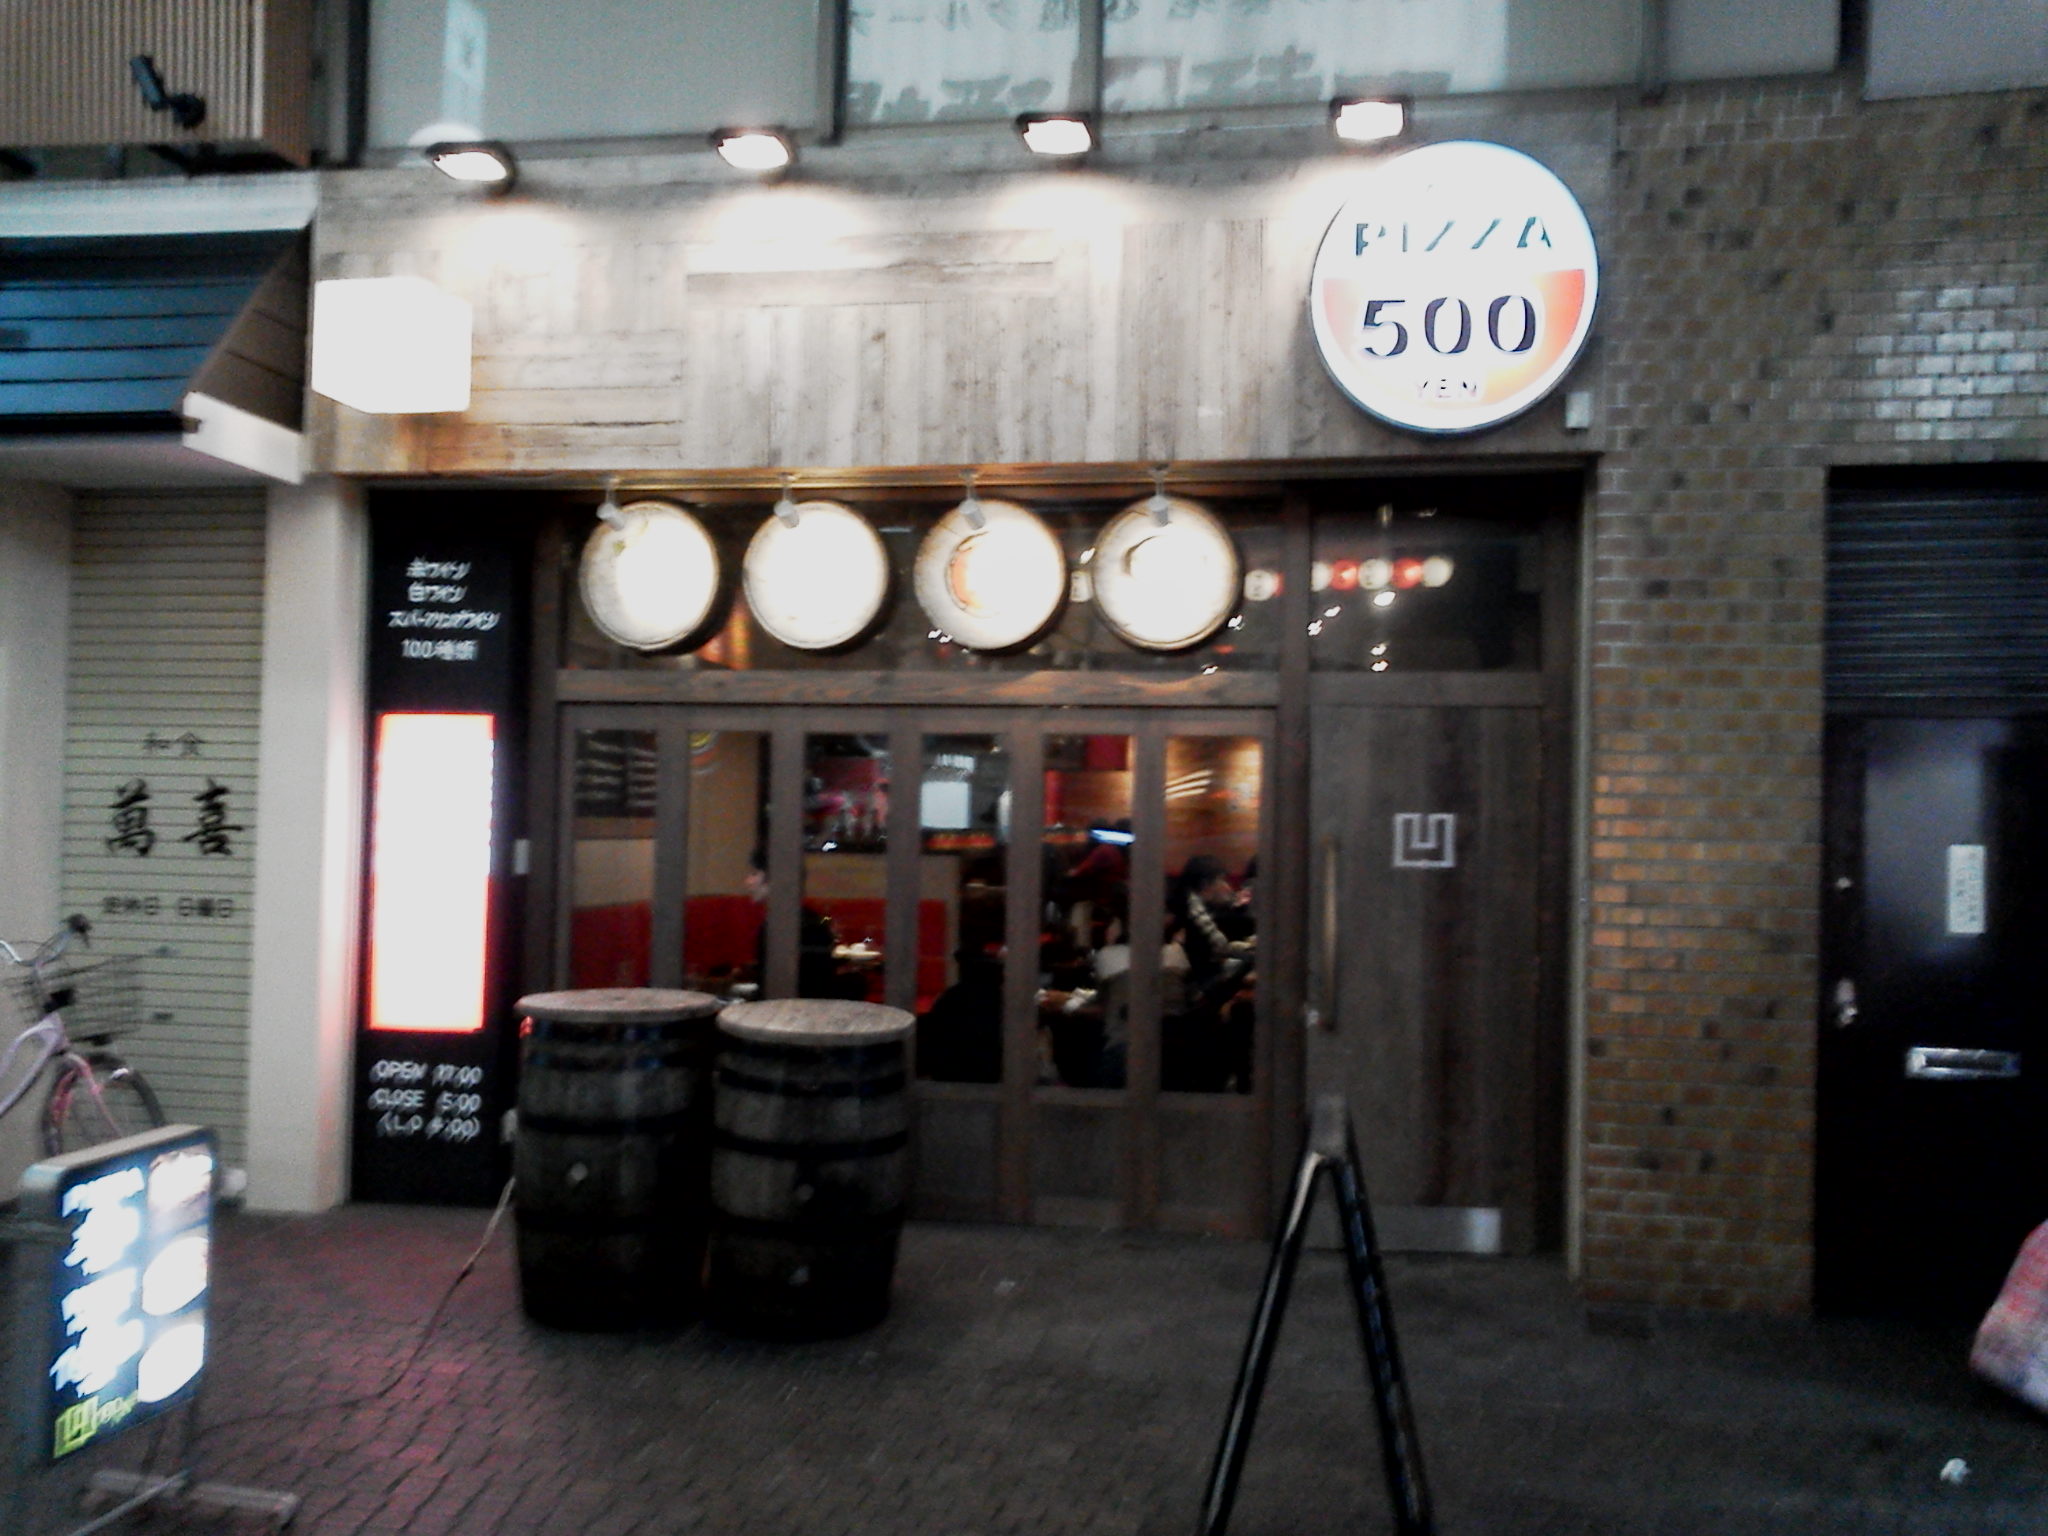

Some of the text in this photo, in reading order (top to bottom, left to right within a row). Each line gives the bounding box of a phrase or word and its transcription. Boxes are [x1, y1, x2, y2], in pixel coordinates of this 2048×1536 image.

[1355, 215, 1553, 257] PIZZA
[1362, 294, 1538, 358] 500
[1414, 377, 1479, 399] YEN
[407, 581, 468, 604] 白ワイン
[369, 1059, 428, 1083] OPEN
